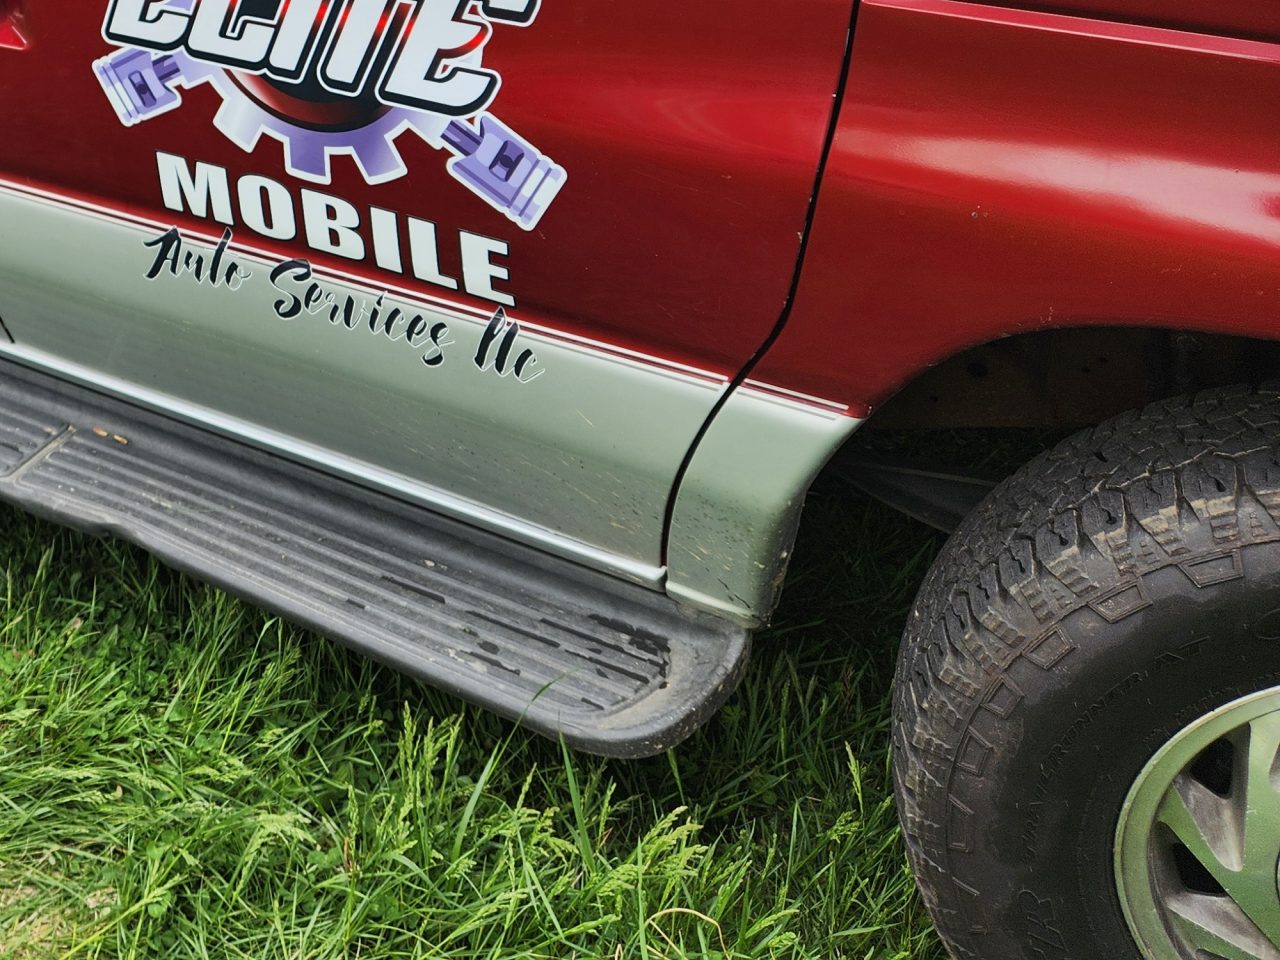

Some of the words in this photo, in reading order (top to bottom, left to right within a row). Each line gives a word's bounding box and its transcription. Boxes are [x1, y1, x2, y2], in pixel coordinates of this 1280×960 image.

[142, 225, 251, 290] Auto
[269, 258, 455, 367] Services
[155, 150, 516, 308] MOBILE
